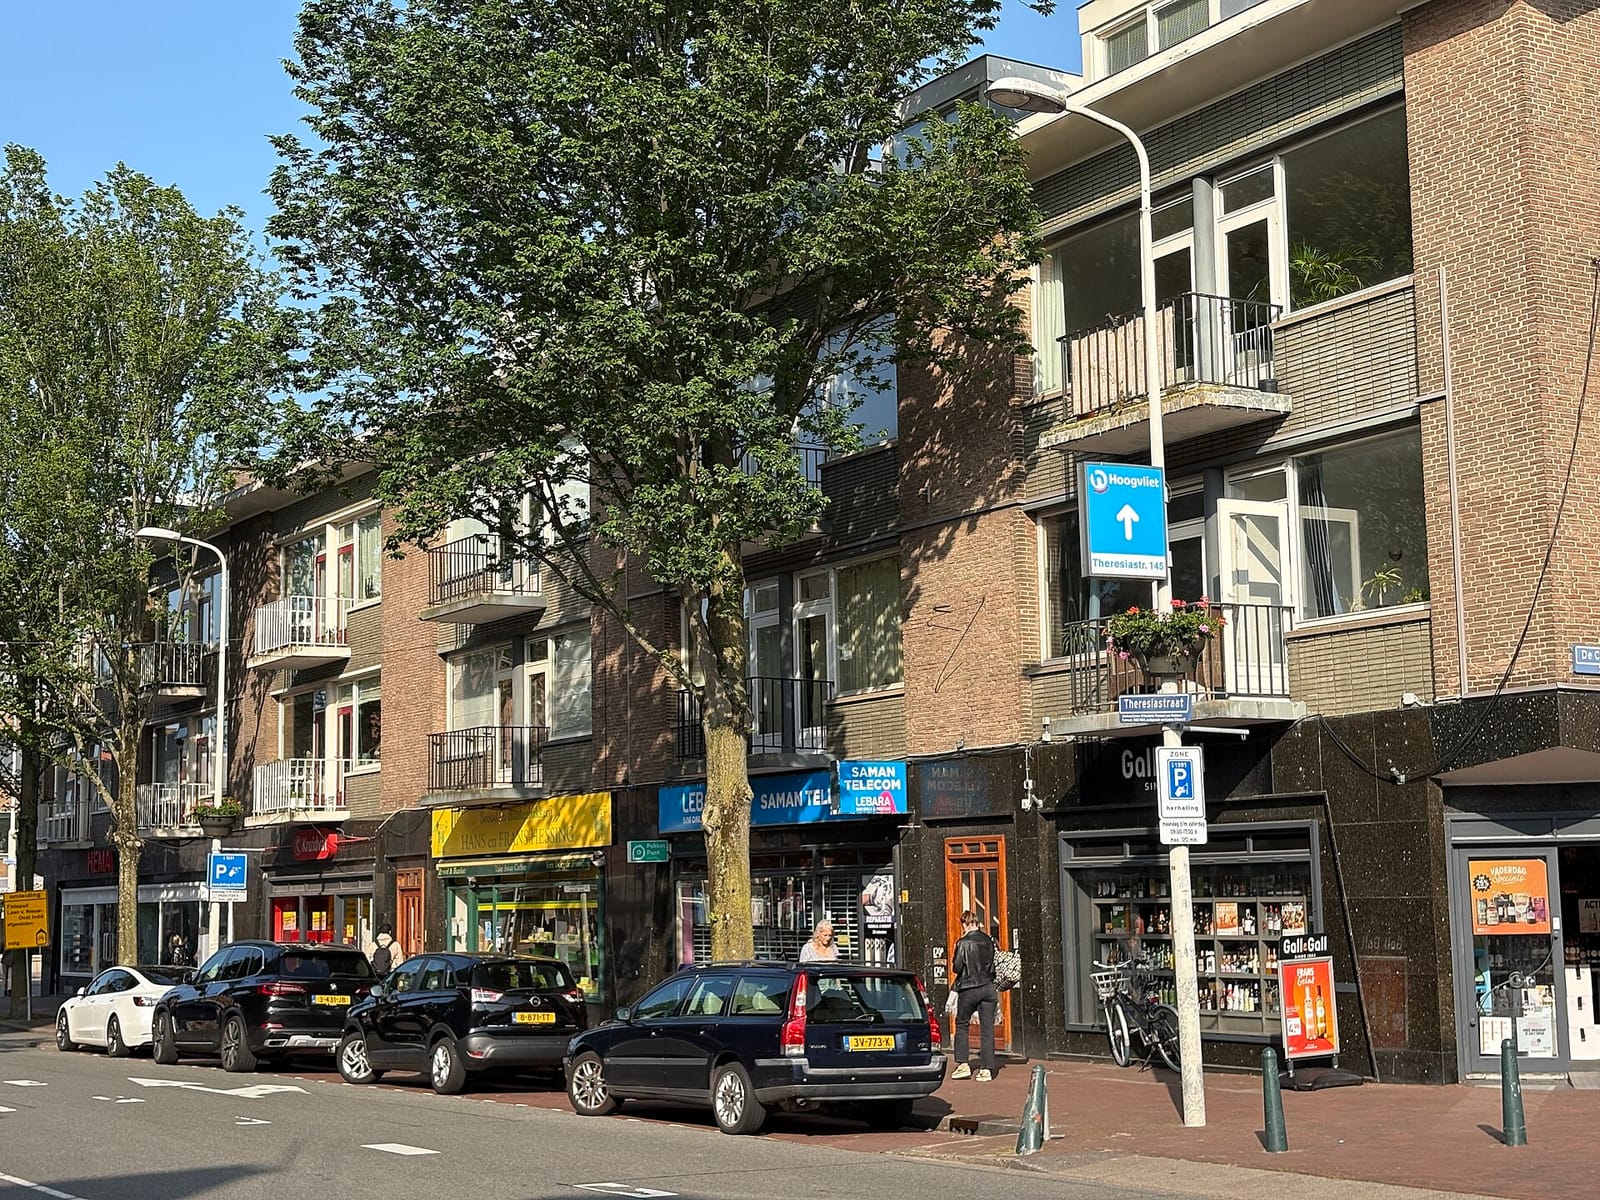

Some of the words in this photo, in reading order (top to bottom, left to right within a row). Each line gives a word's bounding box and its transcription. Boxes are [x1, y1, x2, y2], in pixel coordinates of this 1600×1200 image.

[1108, 473, 1160, 489] Hoogvliet
[1092, 558, 1148, 570] Theresiastr.
[1150, 561, 1164, 571] 145
[1581, 649, 1593, 660] De
[1123, 697, 1184, 710] Theresiastraat
[851, 766, 896, 778] SAMAN
[844, 779, 901, 791] TELECOM
[760, 791, 802, 809] SAMAN
[855, 796, 891, 806] LEBARA
[461, 833, 486, 850] HANS
[498, 829, 528, 847] FRANS
[531, 825, 574, 845] HESSING
[87, 849, 113, 874] HEMA
[1489, 866, 1528, 875] VADERDAG
